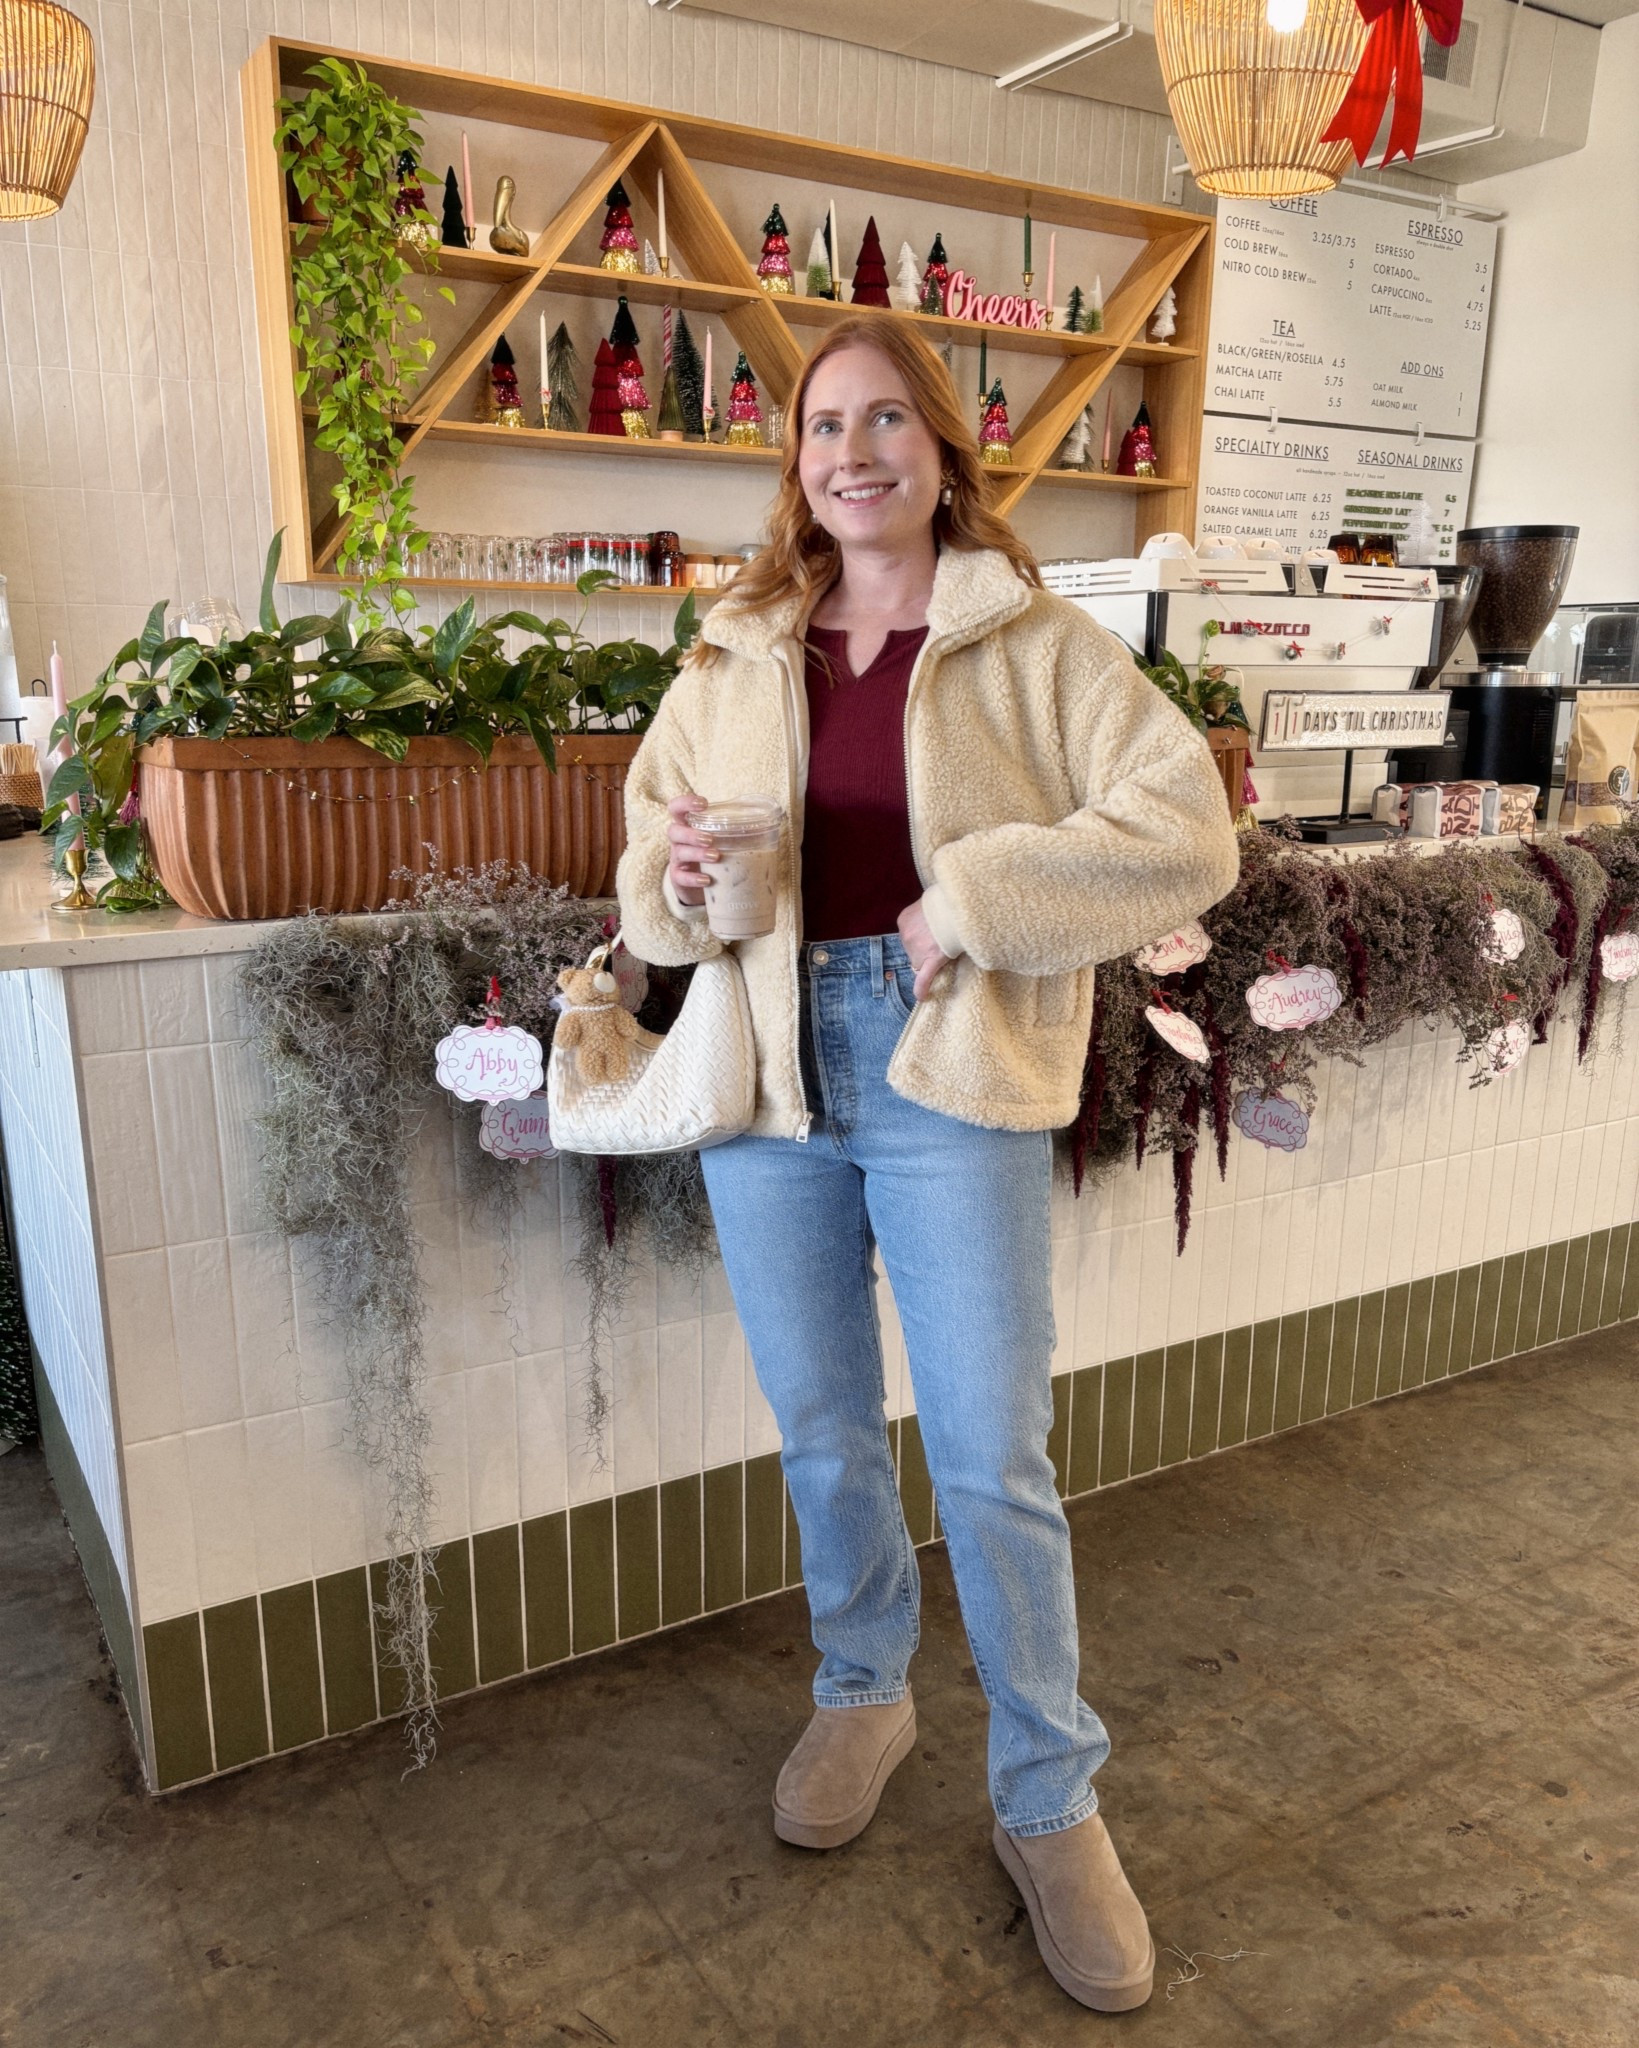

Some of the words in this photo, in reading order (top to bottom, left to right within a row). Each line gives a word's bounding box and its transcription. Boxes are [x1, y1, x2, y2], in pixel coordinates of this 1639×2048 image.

[1270, 197, 1318, 215] COFFEE
[1225, 215, 1260, 231] COFFEE
[1312, 231, 1356, 249] 3.25/3.75
[1408, 219, 1463, 244] ESPRESSO
[1224, 237, 1249, 251] COLD
[1252, 242, 1278, 256] BREW
[1349, 259, 1354, 269] 5
[1375, 243, 1415, 260] ESPRESSO
[1475, 263, 1488, 274] 3.5
[1222, 260, 1251, 274] NITRO
[1254, 265, 1279, 278] COLD
[1282, 269, 1307, 282] BREW
[1347, 280, 1352, 290] 5
[1373, 263, 1413, 280] CORTADO
[1480, 284, 1486, 293] 4
[945, 268, 1047, 331] Cheers
[1371, 284, 1425, 302] CAPPUCCINO
[1466, 300, 1484, 313] 4.75
[1273, 319, 1296, 336] TEA
[1369, 304, 1392, 316] LATTE
[1464, 319, 1482, 331] 5.25
[1217, 343, 1323, 366] BLACK/GREEN/ROSELLA
[1332, 358, 1346, 369] 4.5
[1216, 364, 1254, 379] MATCHA
[1257, 369, 1283, 382] LATTE
[1324, 375, 1344, 387] 5.75
[1401, 361, 1420, 374] ADD
[1424, 364, 1444, 377] ONS
[1214, 385, 1237, 398] CHAI
[1240, 388, 1265, 401] LATTE
[1328, 397, 1342, 408] 5.5
[1373, 382, 1386, 392] OAT
[1388, 384, 1403, 394] MILK
[1371, 399, 1400, 409] ALMOND
[1402, 402, 1418, 411] MILK
[1215, 436, 1280, 455] SPECIALTY
[1284, 442, 1329, 460] DRINKS
[1358, 449, 1418, 468] SEASONAL
[1422, 455, 1463, 471] DRINKS
[1205, 486, 1240, 497] TOASTED
[1243, 489, 1283, 500] COCONUT
[1286, 492, 1307, 502] LATTE
[1312, 493, 1332, 503] 6.25
[1402, 490, 1424, 501] LATTE
[1203, 504, 1239, 516] ORANGE
[1242, 507, 1274, 518] VANILLA
[1276, 509, 1298, 519] LATTE
[1311, 511, 1330, 521] 6.25
[1444, 509, 1450, 517] 7
[1202, 523, 1231, 534] SALTED
[1234, 525, 1272, 537] CARAMEL
[1275, 528, 1297, 538] LATTE
[1309, 529, 1328, 539] 6.25
[1284, 545, 1302, 555] ATTE
[1303, 711, 1338, 732] DAYS
[1342, 711, 1366, 732] 'TIL
[1371, 710, 1443, 731] CHRISTMAS
[1267, 985, 1321, 1018] Audrey
[465, 1047, 518, 1088] Abby
[1252, 1104, 1298, 1135] Grace
